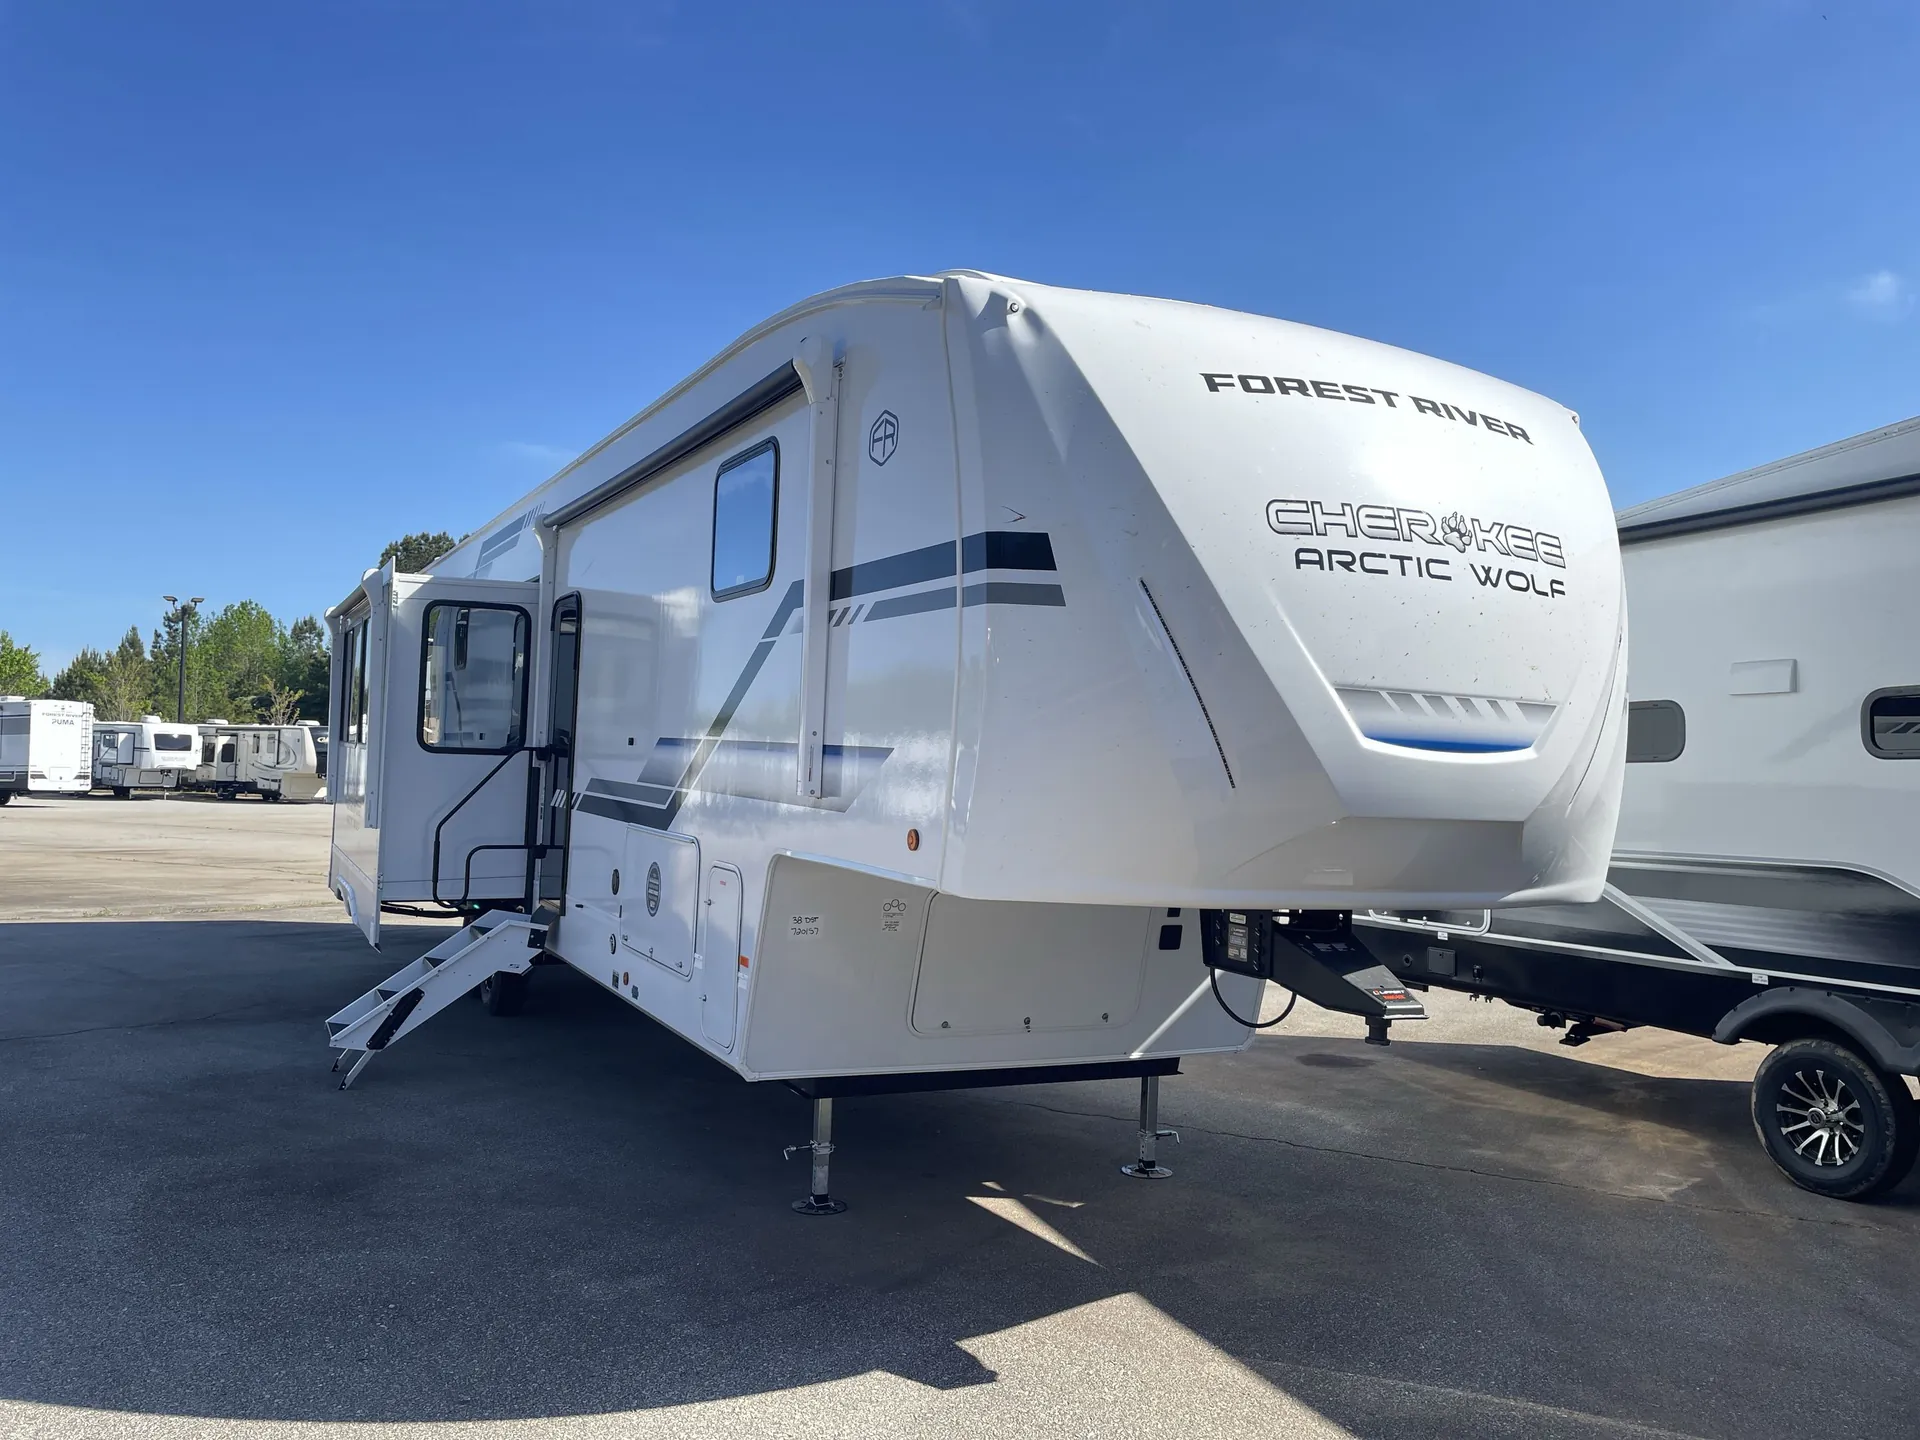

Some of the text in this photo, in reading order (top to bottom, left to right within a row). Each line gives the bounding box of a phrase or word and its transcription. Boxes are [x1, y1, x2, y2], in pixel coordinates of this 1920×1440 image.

[1199, 372, 1534, 445] FOREST RIVER
[1295, 547, 1566, 598] ARCTIC WOLF
[793, 916, 803, 925] 38
